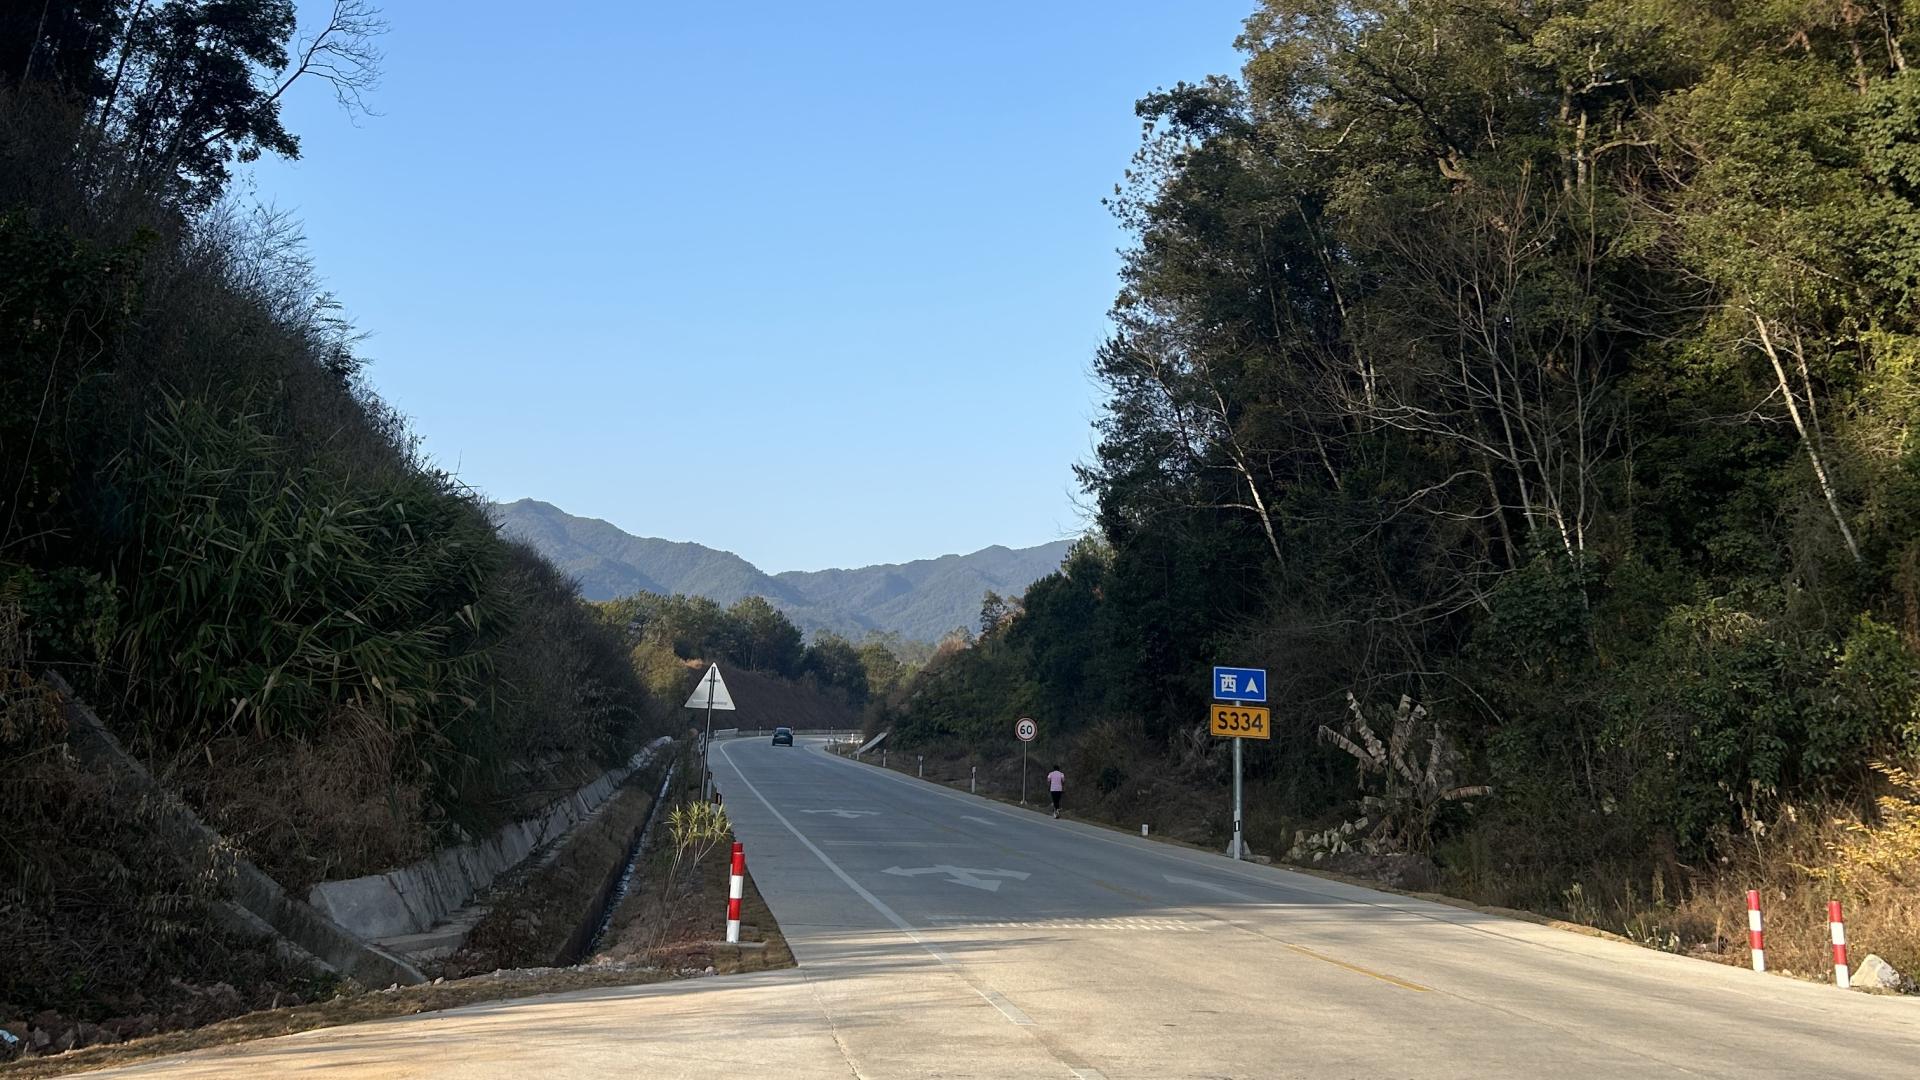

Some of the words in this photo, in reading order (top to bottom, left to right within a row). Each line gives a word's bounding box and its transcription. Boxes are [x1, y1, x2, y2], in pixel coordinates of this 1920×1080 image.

[1219, 674, 1237, 693] 西
[1020, 725, 1033, 735] 60
[1217, 711, 1263, 732] S334
